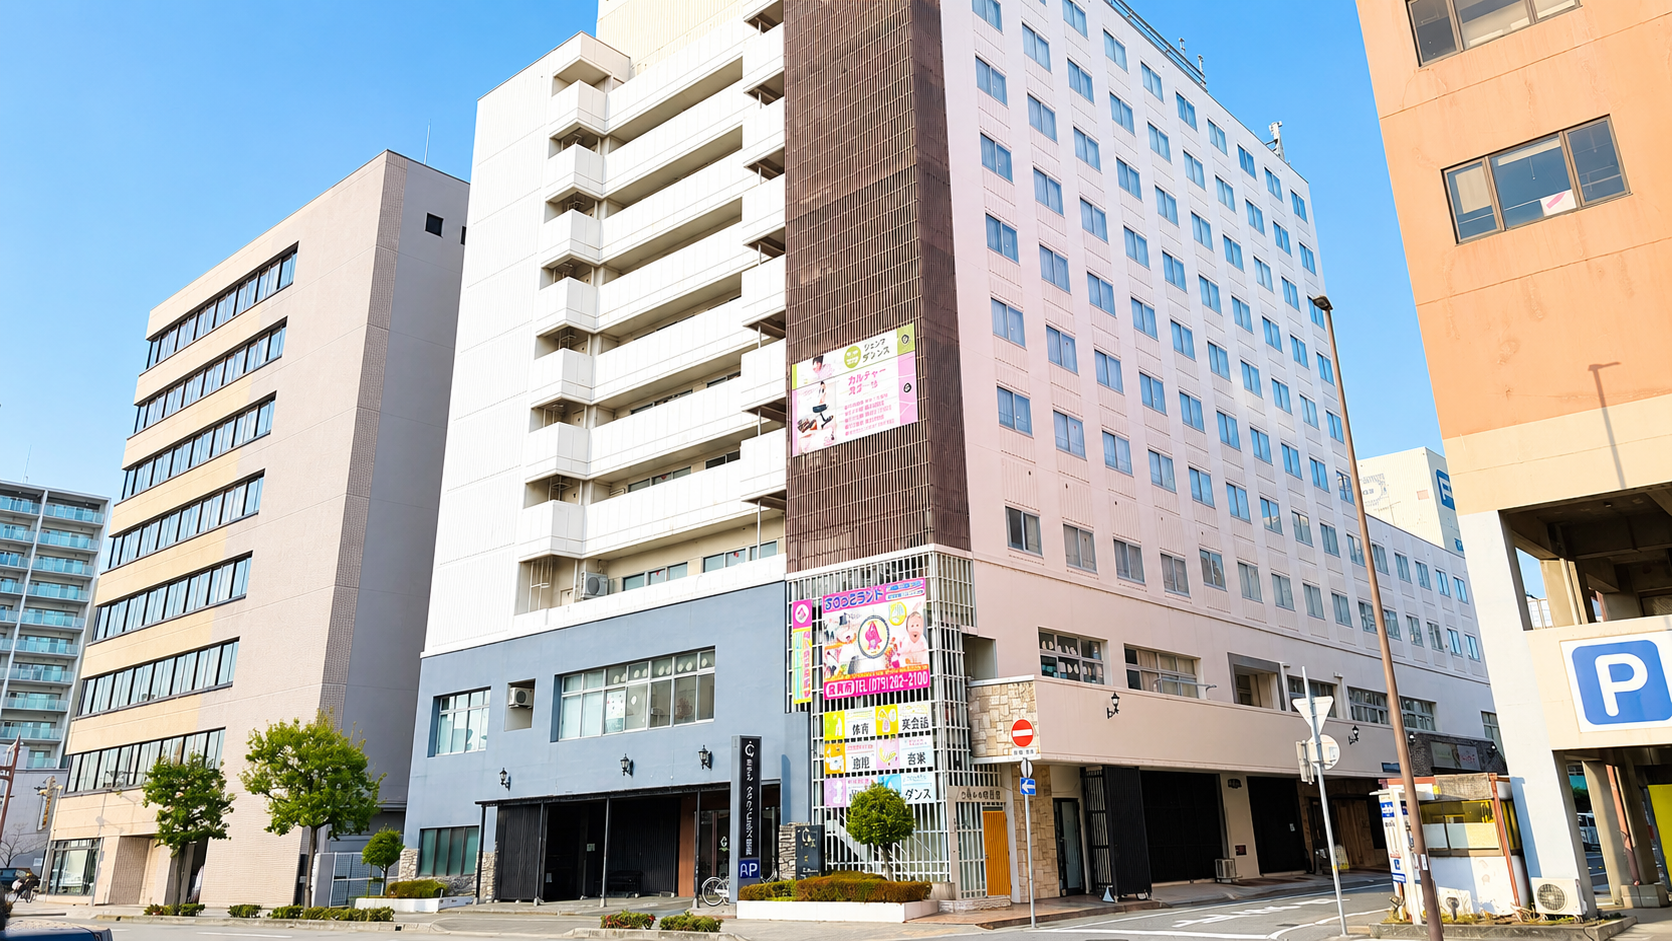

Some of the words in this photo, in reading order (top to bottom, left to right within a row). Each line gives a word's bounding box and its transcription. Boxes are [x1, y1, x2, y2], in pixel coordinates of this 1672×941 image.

[1595, 653, 1648, 717] P
[904, 788, 932, 801] ダンス
[740, 862, 758, 878] AP
